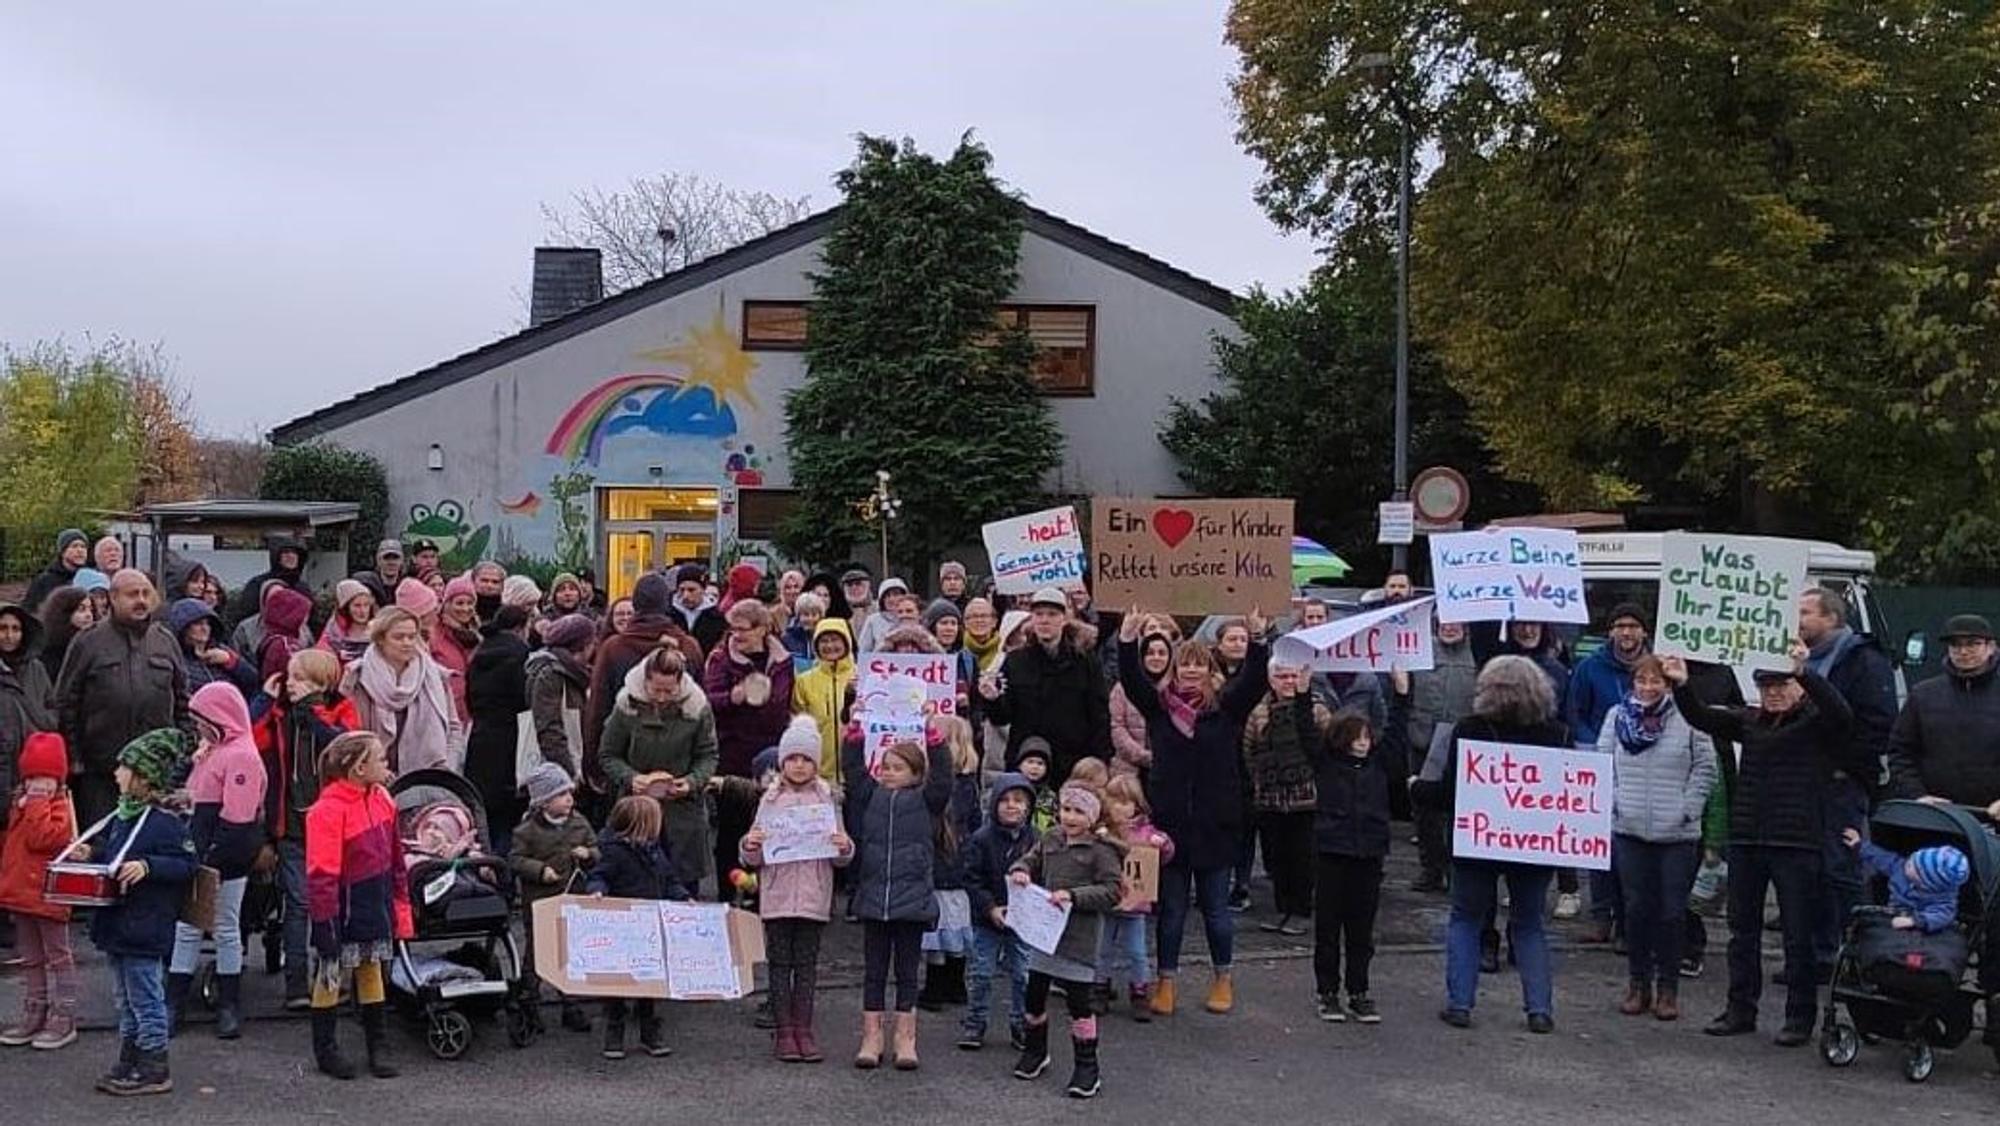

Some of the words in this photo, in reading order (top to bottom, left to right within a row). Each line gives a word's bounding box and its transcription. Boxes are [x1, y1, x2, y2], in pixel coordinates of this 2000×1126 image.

[1109, 508, 1146, 533] Ein
[1196, 515, 1227, 543] für
[1231, 509, 1286, 538] Kinder
[1099, 551, 1158, 583] Rettet
[1170, 560, 1228, 579] unsere
[1235, 550, 1277, 579] Kita
[1440, 550, 1501, 567] Kurze
[1510, 538, 1579, 567] Beine
[1701, 544, 1756, 571] Was
[1447, 582, 1516, 600] Kurze
[1515, 571, 1580, 609] Wege
[1675, 589, 1713, 616] Ihr
[1716, 596, 1783, 629] Euch
[1466, 749, 1542, 785] Kita
[1564, 762, 1598, 787] im
